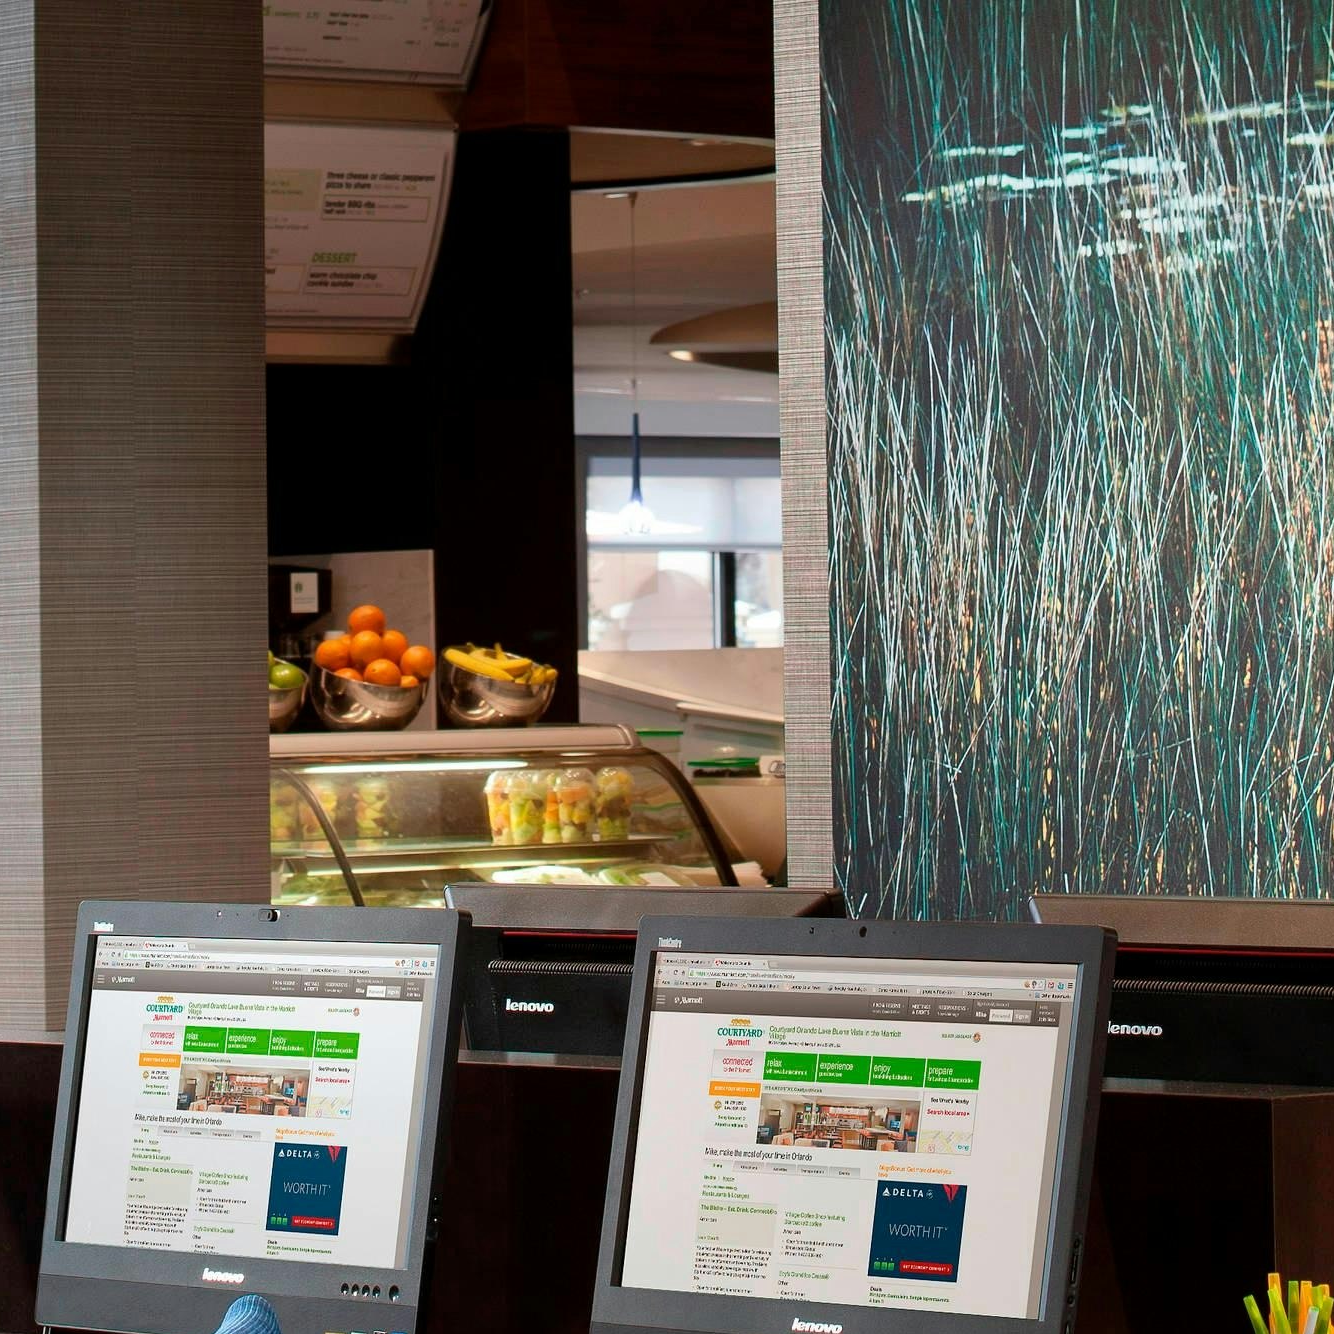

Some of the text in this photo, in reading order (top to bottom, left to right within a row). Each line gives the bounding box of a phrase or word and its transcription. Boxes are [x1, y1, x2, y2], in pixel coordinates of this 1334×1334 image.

[312, 252, 357, 263] DESSERT
[146, 1004, 184, 1014] COURTYARD
[506, 998, 554, 1012] lenovo
[717, 1027, 763, 1038] COURTYARD
[1108, 1021, 1163, 1036] lenovo
[722, 1056, 753, 1066] connected
[767, 1059, 954, 1076] relax experience enjoy prepare
[287, 1149, 312, 1158] DELTA
[283, 1182, 317, 1194] WORTH
[893, 1187, 924, 1198] DELTA
[889, 1223, 931, 1239] WORTH
[202, 1267, 245, 1283] lenovo
[792, 1317, 843, 1334] lenovo
